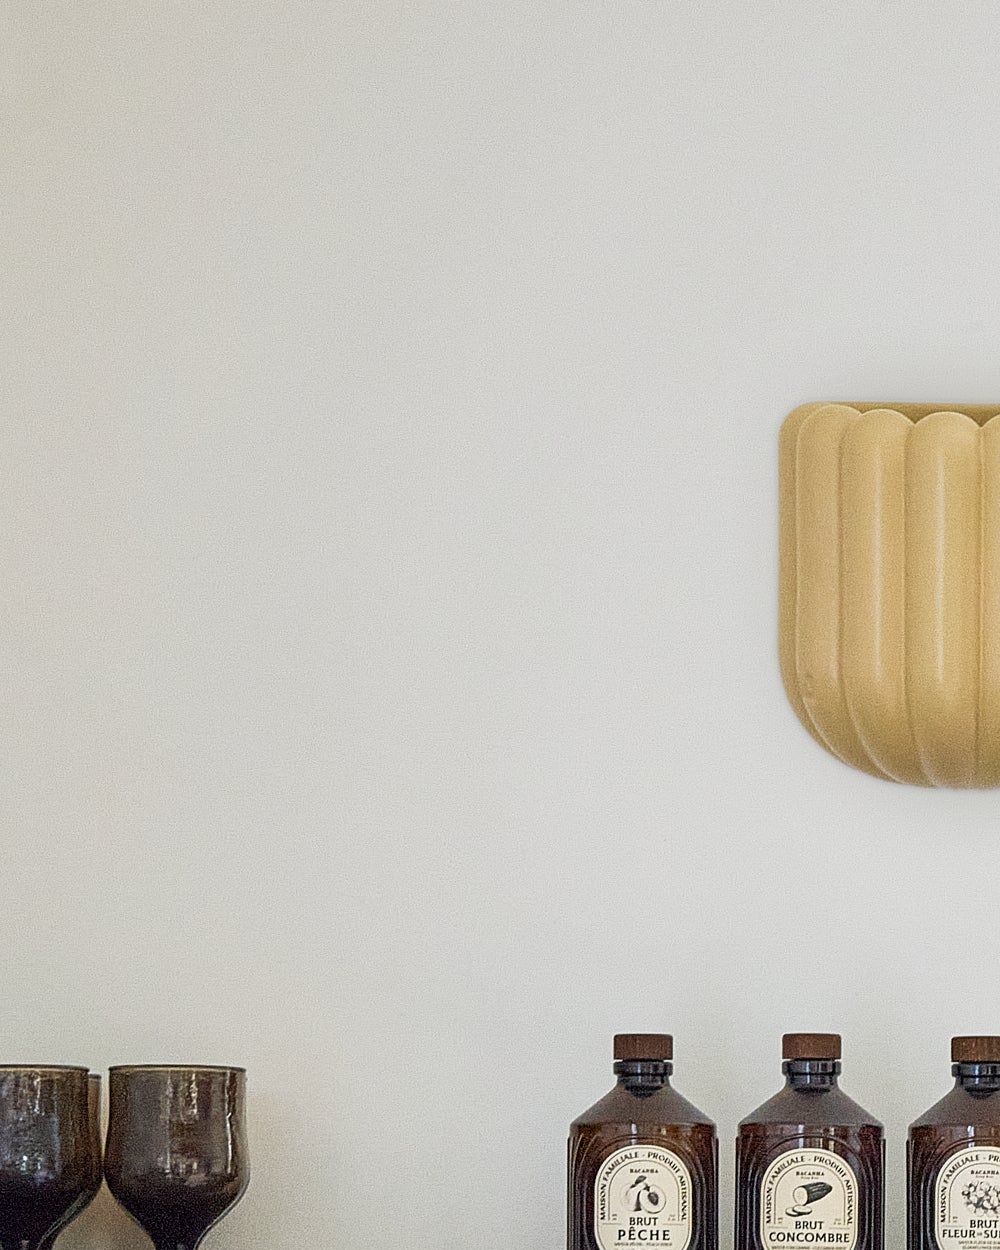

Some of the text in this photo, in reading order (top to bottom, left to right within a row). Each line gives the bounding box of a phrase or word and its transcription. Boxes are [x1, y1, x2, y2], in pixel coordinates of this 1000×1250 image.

[943, 1153, 980, 1183] FAMILIALE
[603, 1151, 639, 1180] FAMILIALE
[647, 1151, 680, 1174] PRODUIT
[677, 1175, 687, 1220] ARTISANAL
[765, 1155, 854, 1225] MAISON FAMILIALE PRODUIT ARTISANAL
[629, 1216, 659, 1226] BRUT
[794, 1220, 825, 1230] BRUT
[969, 1219, 999, 1229] BRUT
[617, 1226, 671, 1241] PÊCHE
[768, 1231, 850, 1243] CONCOMBRE
[942, 1228, 976, 1239] FLEUR
